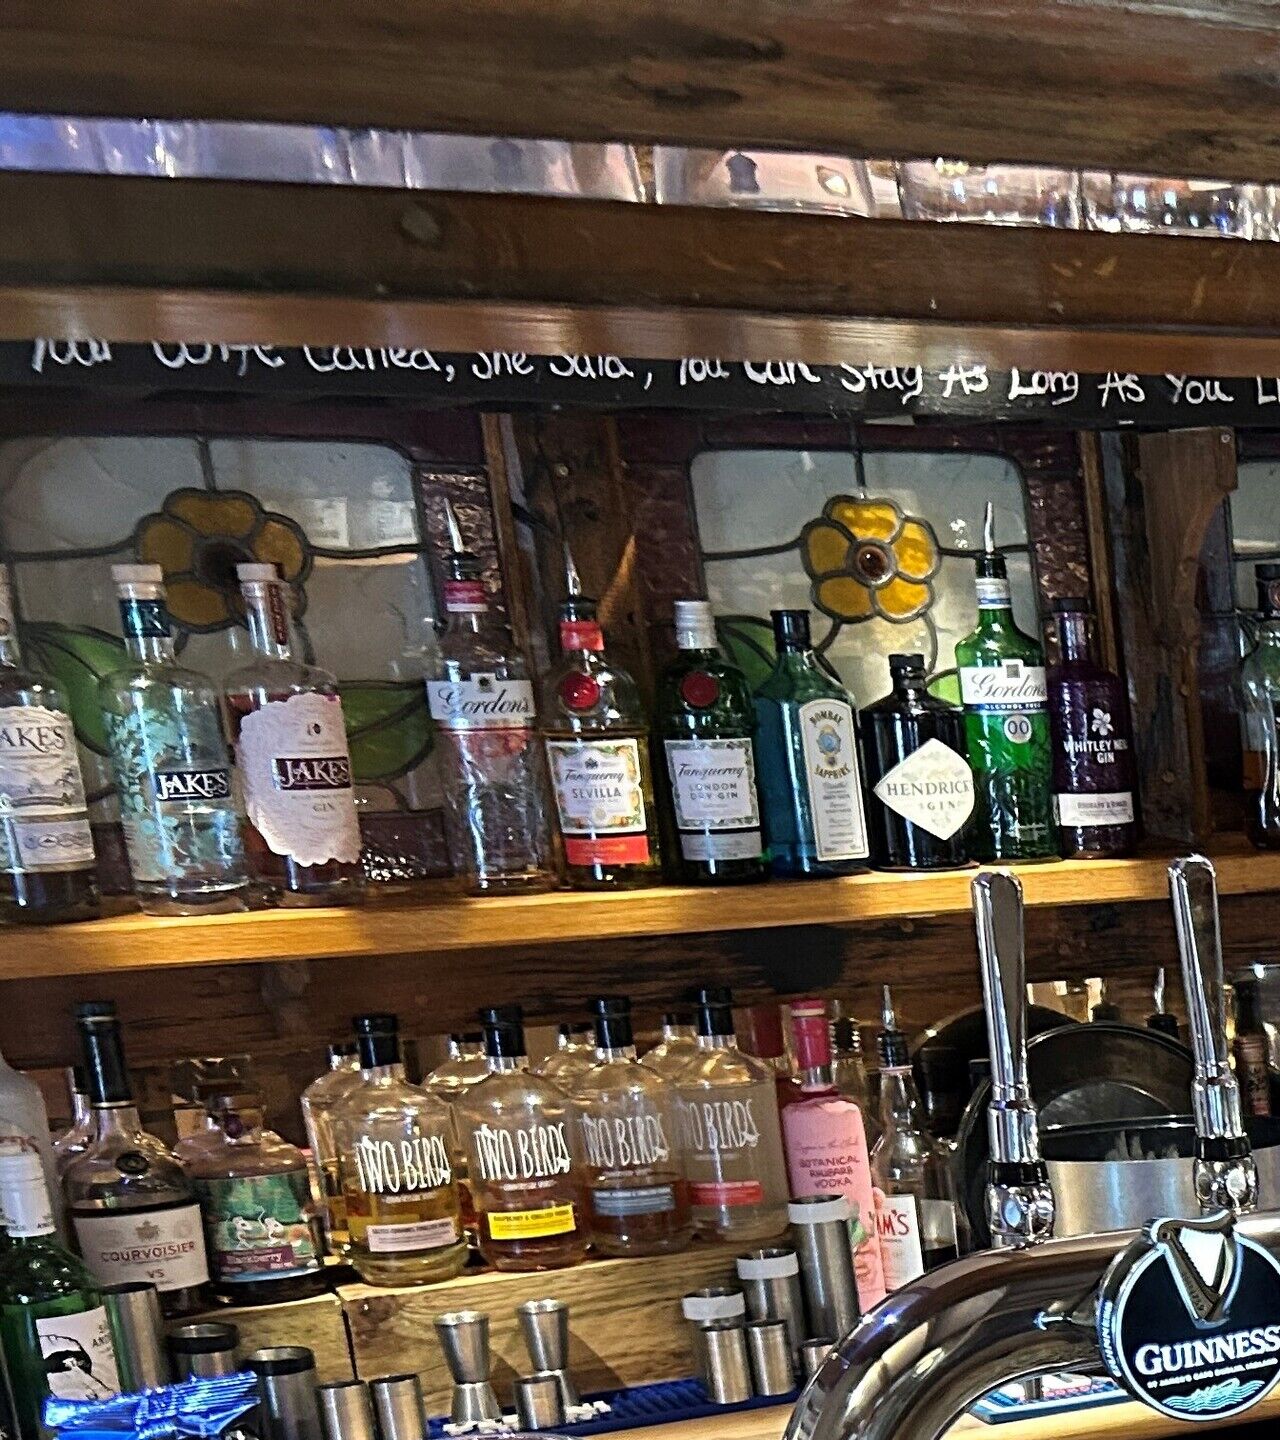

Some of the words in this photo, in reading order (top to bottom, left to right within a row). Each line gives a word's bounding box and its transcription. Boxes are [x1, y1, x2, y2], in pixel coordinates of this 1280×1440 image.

[840, 363, 924, 405] Stay
[1009, 366, 1079, 407] Long
[1098, 370, 1147, 408] As
[1165, 371, 1235, 405] You
[438, 682, 531, 714] Gordon's
[1063, 740, 1111, 752] WHITLEY
[1097, 752, 1115, 763] GIN
[156, 771, 230, 801] JAKES
[280, 759, 351, 789] JAKES
[571, 787, 622, 799] SEVILLA
[617, 1113, 670, 1165] BIRDS
[704, 1099, 760, 1149] BIRDS
[354, 1136, 401, 1194] TWO
[401, 1135, 452, 1191] BIRDS
[473, 1123, 517, 1181] TWO
[517, 1121, 572, 1179] BIRDS
[101, 1240, 196, 1264] COURVOISIER
